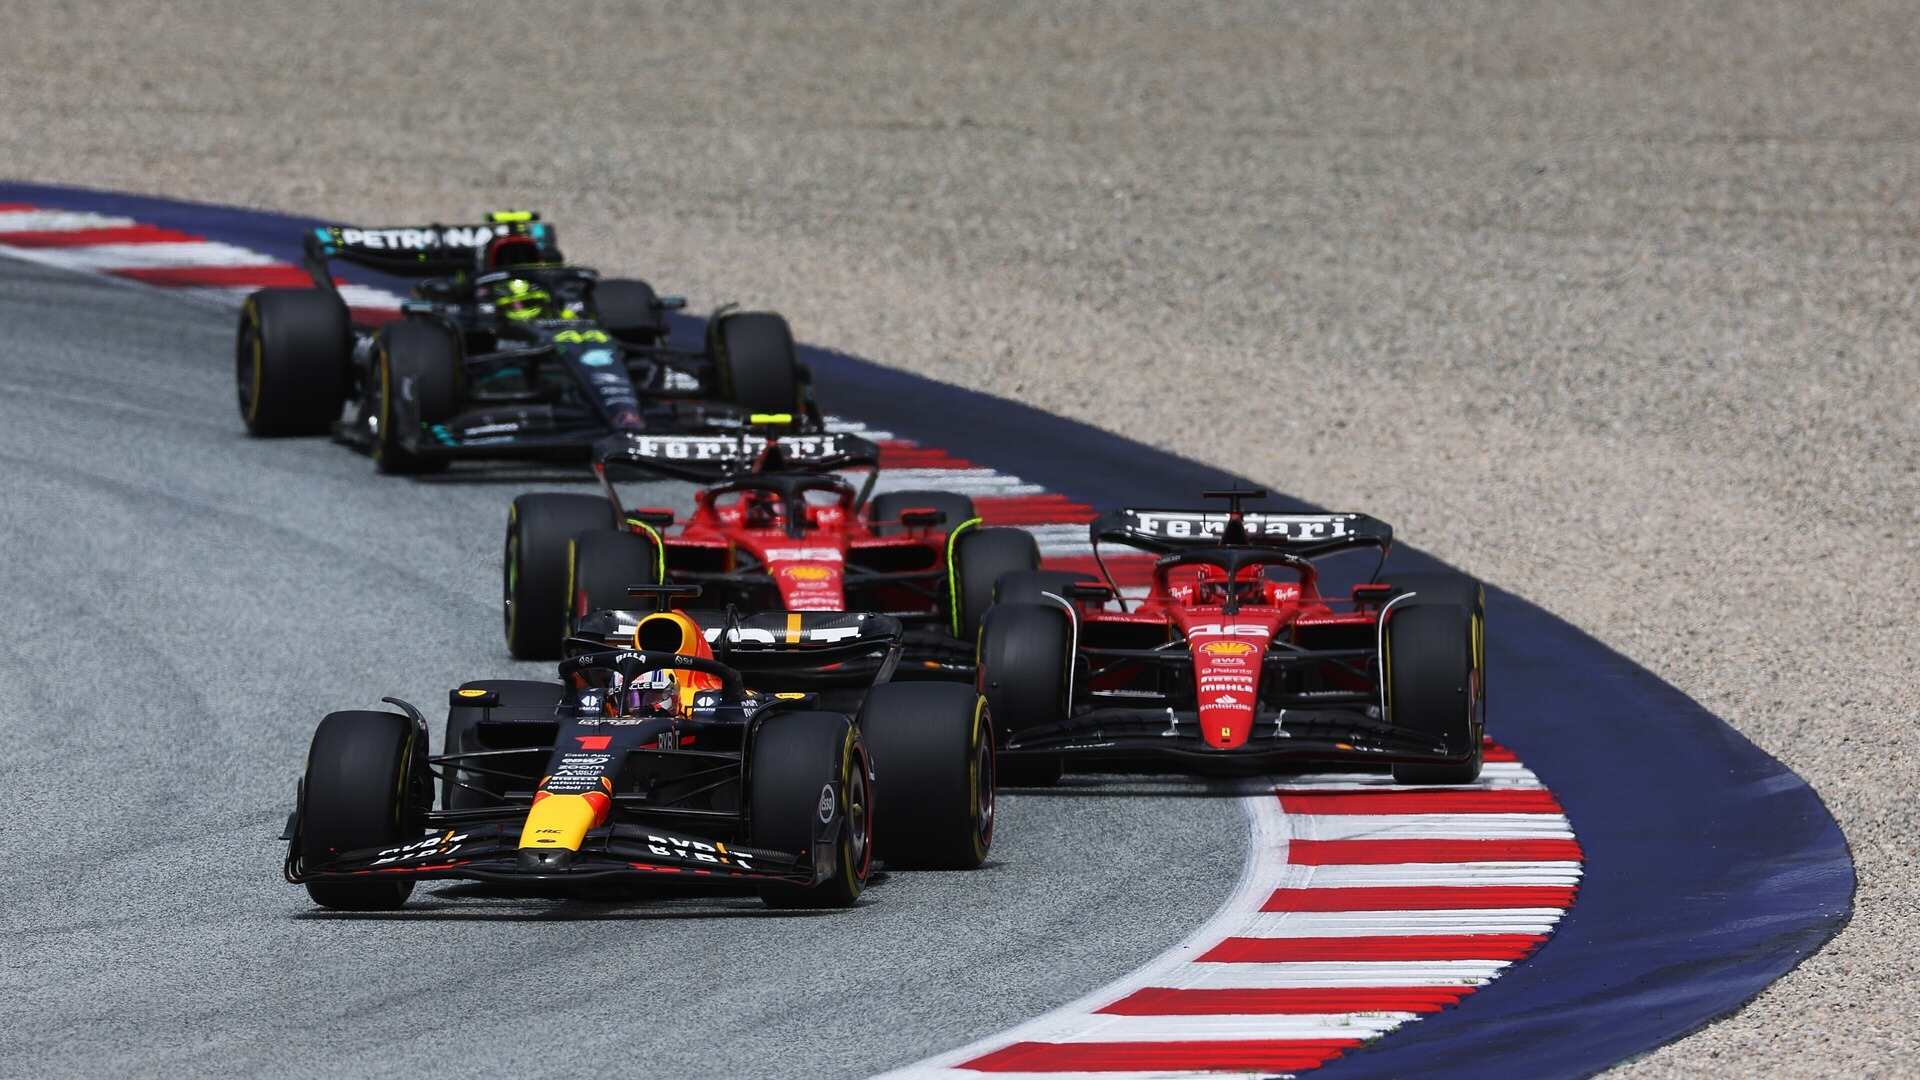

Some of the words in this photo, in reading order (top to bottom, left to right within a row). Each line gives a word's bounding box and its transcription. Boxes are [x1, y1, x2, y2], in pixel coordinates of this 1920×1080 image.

[635, 435, 835, 459] Ferrri
[1188, 624, 1270, 639] 16
[615, 652, 647, 664] BILLA
[574, 736, 613, 750] 1
